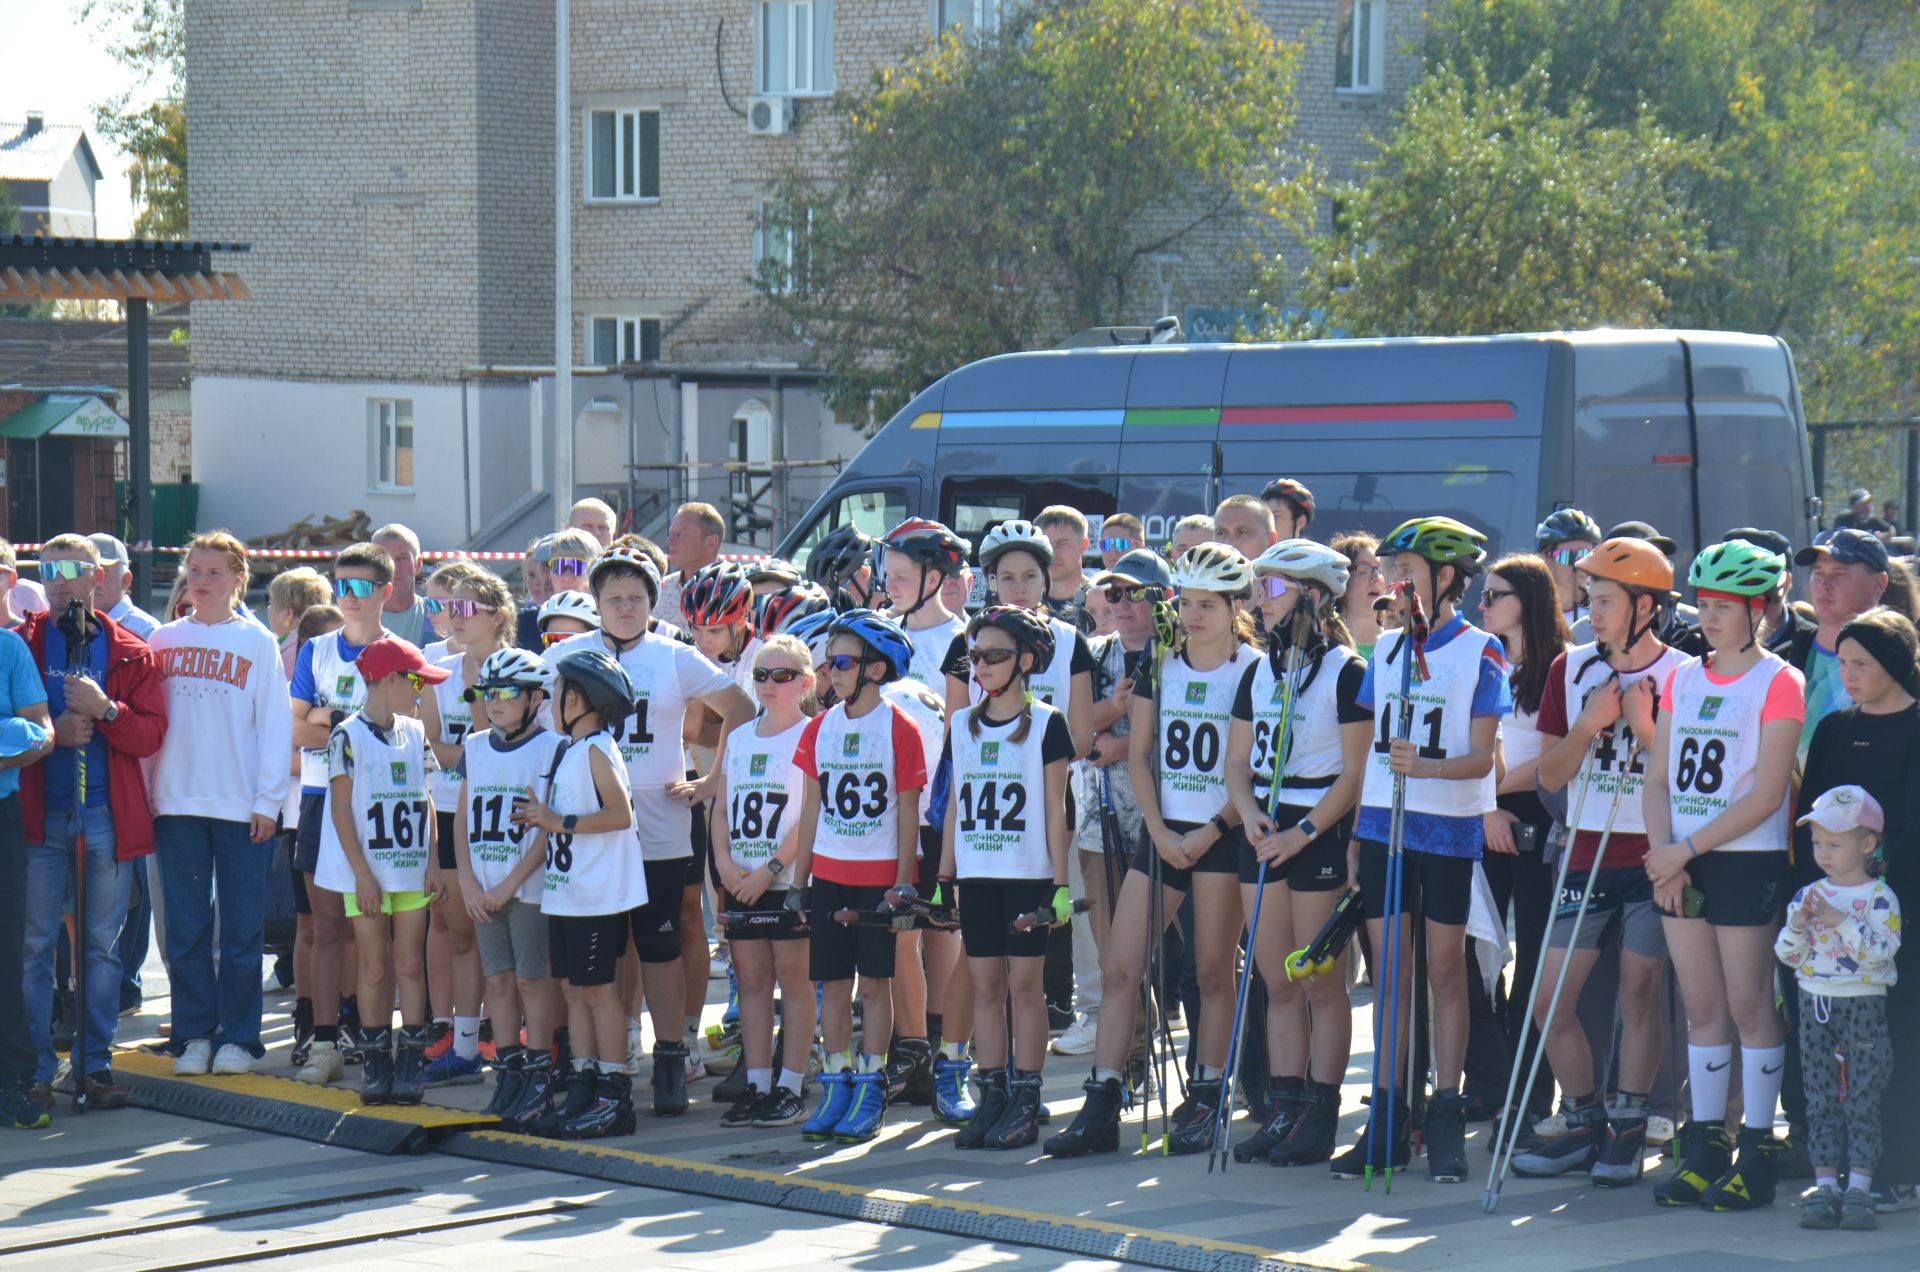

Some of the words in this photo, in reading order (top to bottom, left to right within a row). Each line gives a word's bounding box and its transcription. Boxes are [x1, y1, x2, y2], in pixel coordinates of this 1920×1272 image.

[906, 671, 924, 681] АЙОН
[1421, 694, 1447, 705] РАЙОН
[1204, 712, 1230, 722] РАЙОН
[1714, 728, 1739, 738] РАЙОН
[620, 746, 650, 754] ОРМА
[1165, 719, 1220, 772] 80
[820, 762, 859, 770] АГРЫЗСКИЙ
[860, 761, 883, 769] РАЙОН
[1676, 737, 1726, 794] 68
[999, 771, 1022, 780] РАЙОН
[1190, 774, 1225, 786] НОРМА
[1580, 774, 1609, 783] СОРТ
[1172, 781, 1207, 793] ЖИЗНИ
[819, 771, 888, 819] 163
[959, 781, 1027, 832] 142
[1691, 795, 1728, 809] НОРМА
[470, 794, 530, 844] 115
[730, 791, 789, 841] 187
[367, 800, 428, 850] 167
[848, 820, 882, 829] НОРМА
[986, 833, 1021, 843] НОРМА
